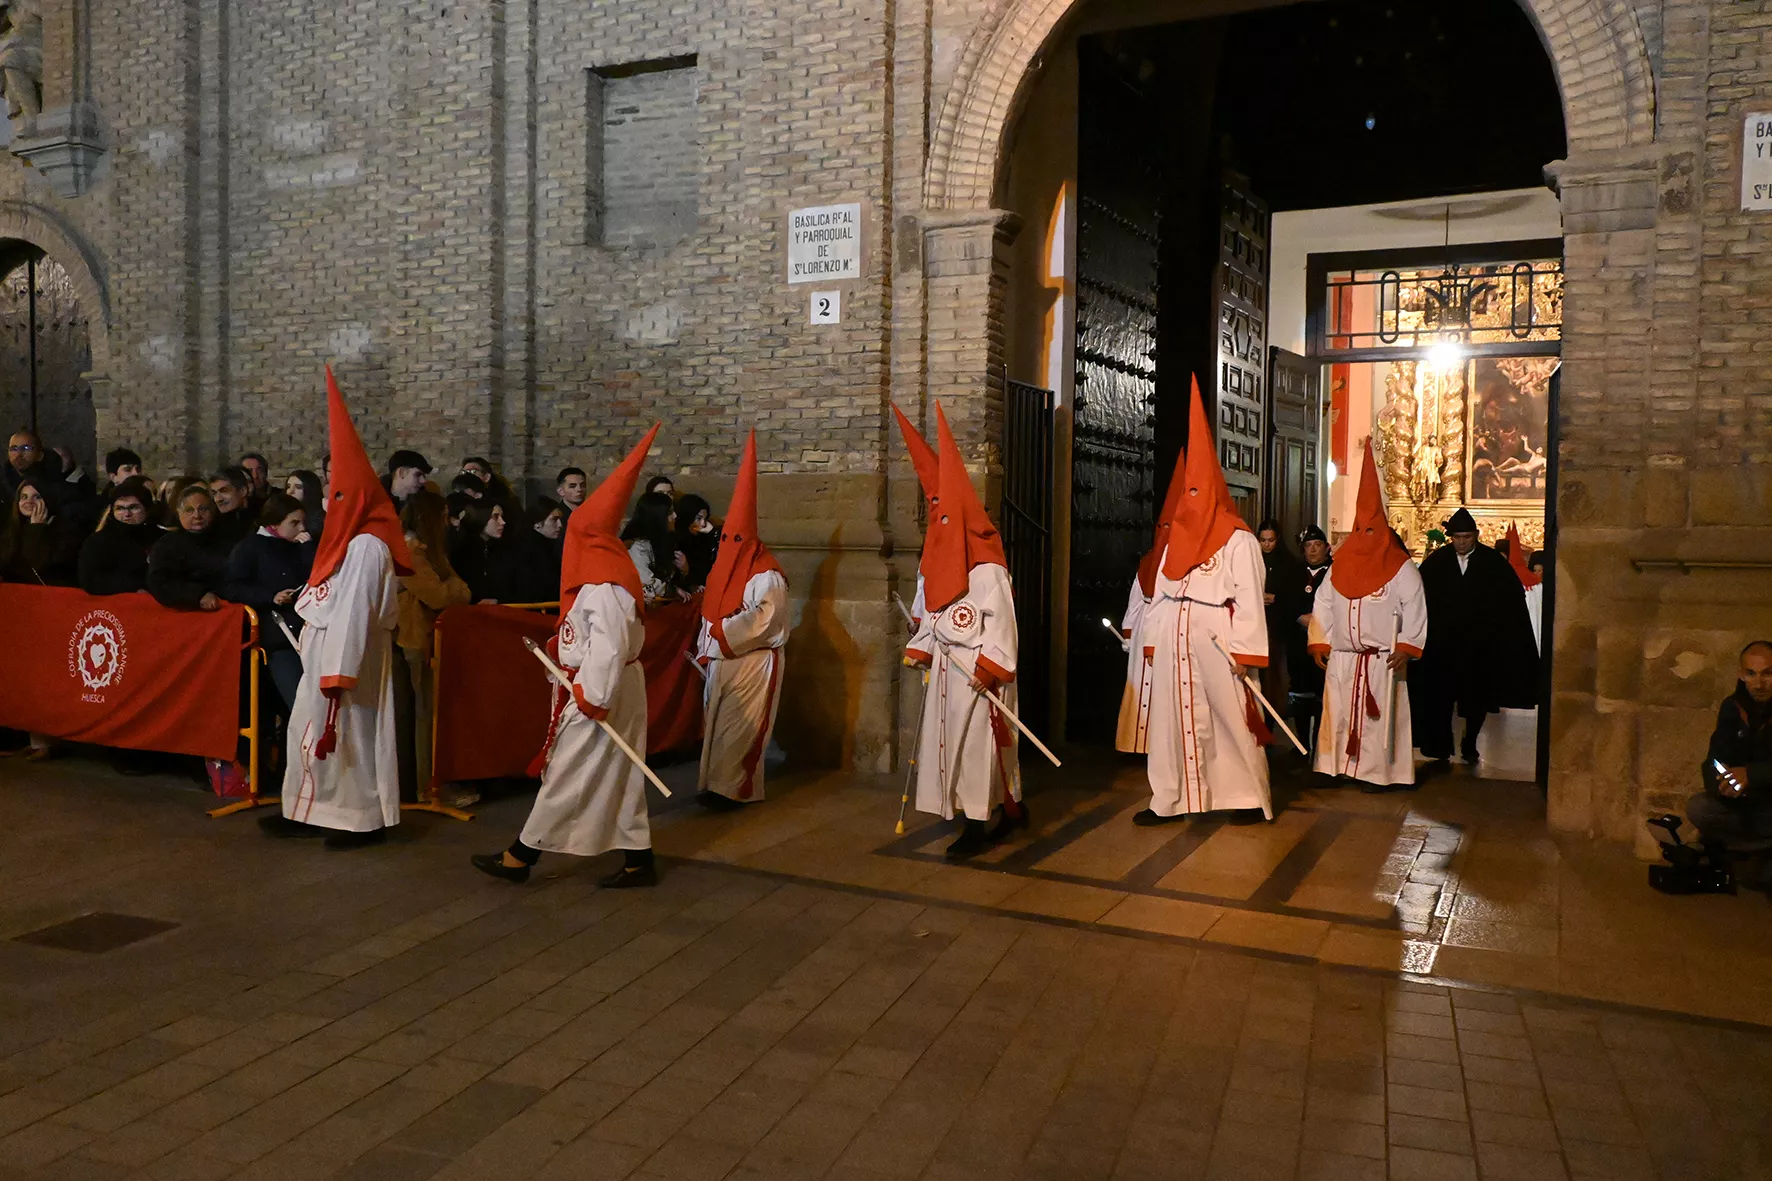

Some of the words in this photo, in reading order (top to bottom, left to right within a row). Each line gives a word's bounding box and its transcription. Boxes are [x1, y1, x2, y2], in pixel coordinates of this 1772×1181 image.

[1756, 143, 1764, 158] Y
[795, 231, 800, 244] Y
[803, 227, 853, 243] PARROQUIAL
[818, 245, 828, 257] DE
[819, 297, 830, 317] 2
[75, 618, 84, 631] DE
[84, 612, 93, 623] LA
[81, 693, 105, 703] HUESCA
